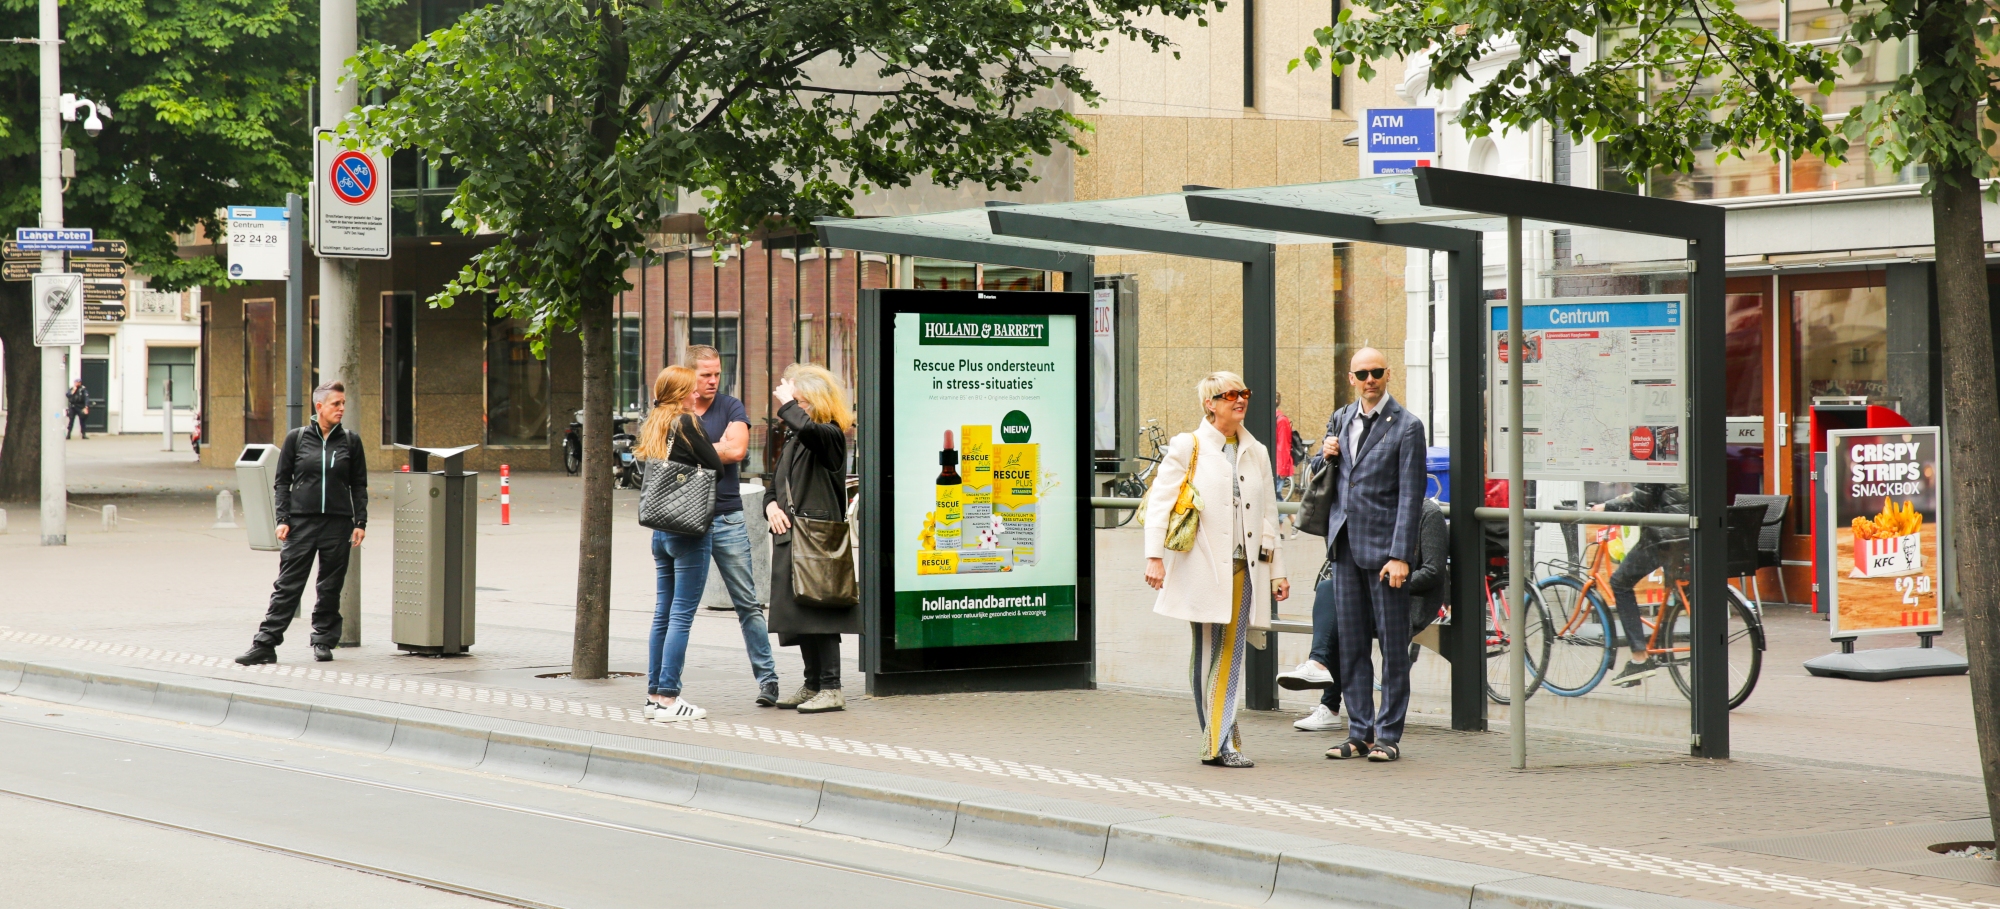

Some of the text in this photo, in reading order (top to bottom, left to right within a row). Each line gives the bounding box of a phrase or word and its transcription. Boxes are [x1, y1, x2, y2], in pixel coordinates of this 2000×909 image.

[1372, 116, 1404, 128] ATM
[1372, 133, 1418, 144] Pinnen
[23, 231, 86, 241] Lange Poten
[266, 235, 278, 243] 28
[1550, 308, 1610, 324] Centrum
[924, 322, 1044, 338] HOLLAND & BARRETT
[913, 359, 1055, 372] Rescue Plus ondersteunt
[933, 377, 943, 389] in
[1652, 390, 1668, 406] 24
[1852, 442, 1920, 462] CRISPY
[994, 471, 1030, 479] RESCUE
[1852, 462, 1920, 482] STRIPS
[1852, 482, 1920, 497] SNACKBOX
[1874, 556, 1895, 568] KFC
[922, 593, 1046, 611] hollandandbarrett.nl
